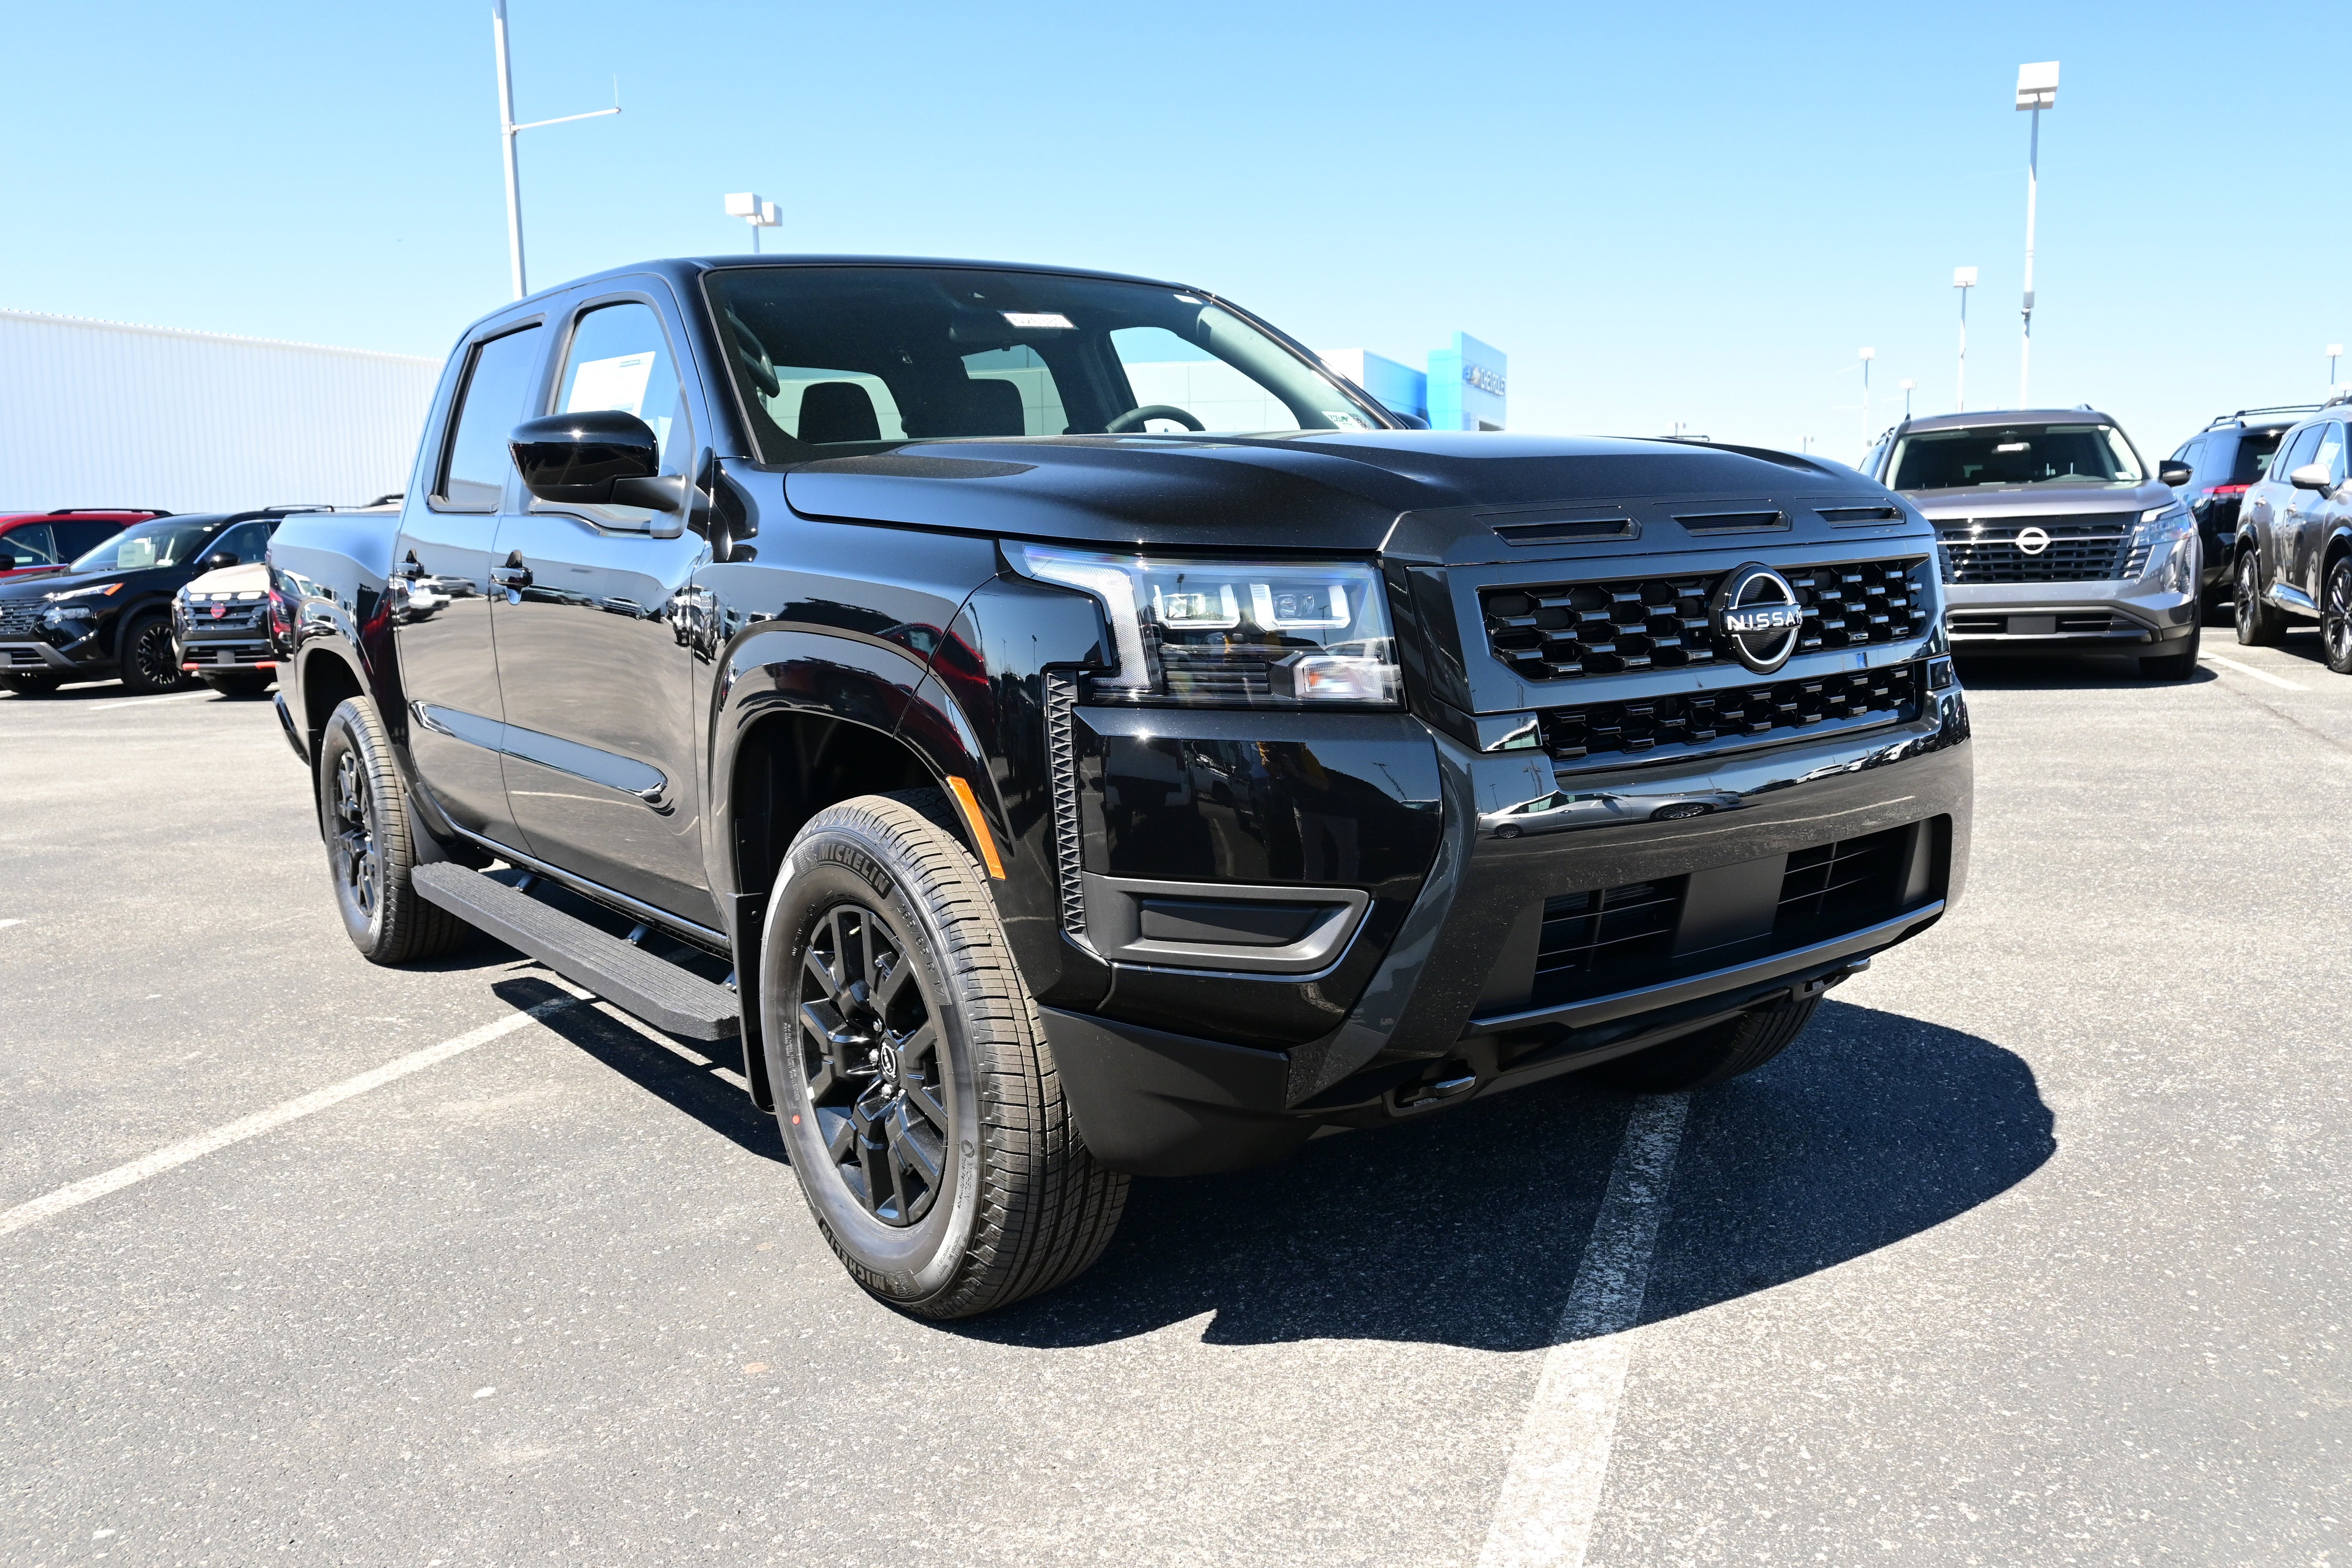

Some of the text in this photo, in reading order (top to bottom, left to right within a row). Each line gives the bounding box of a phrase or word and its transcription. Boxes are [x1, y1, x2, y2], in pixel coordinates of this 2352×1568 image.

[1481, 368, 1506, 395] CHEVROLET
[1727, 610, 1802, 630] NISSAN
[818, 844, 890, 894] MICHELIN
[896, 903, 930, 956] 265/65
[932, 980, 945, 996] 17
[957, 1171, 966, 1209] Performance
[964, 1160, 972, 1202] MICHELIN
[821, 1223, 886, 1291] MICHELIN
